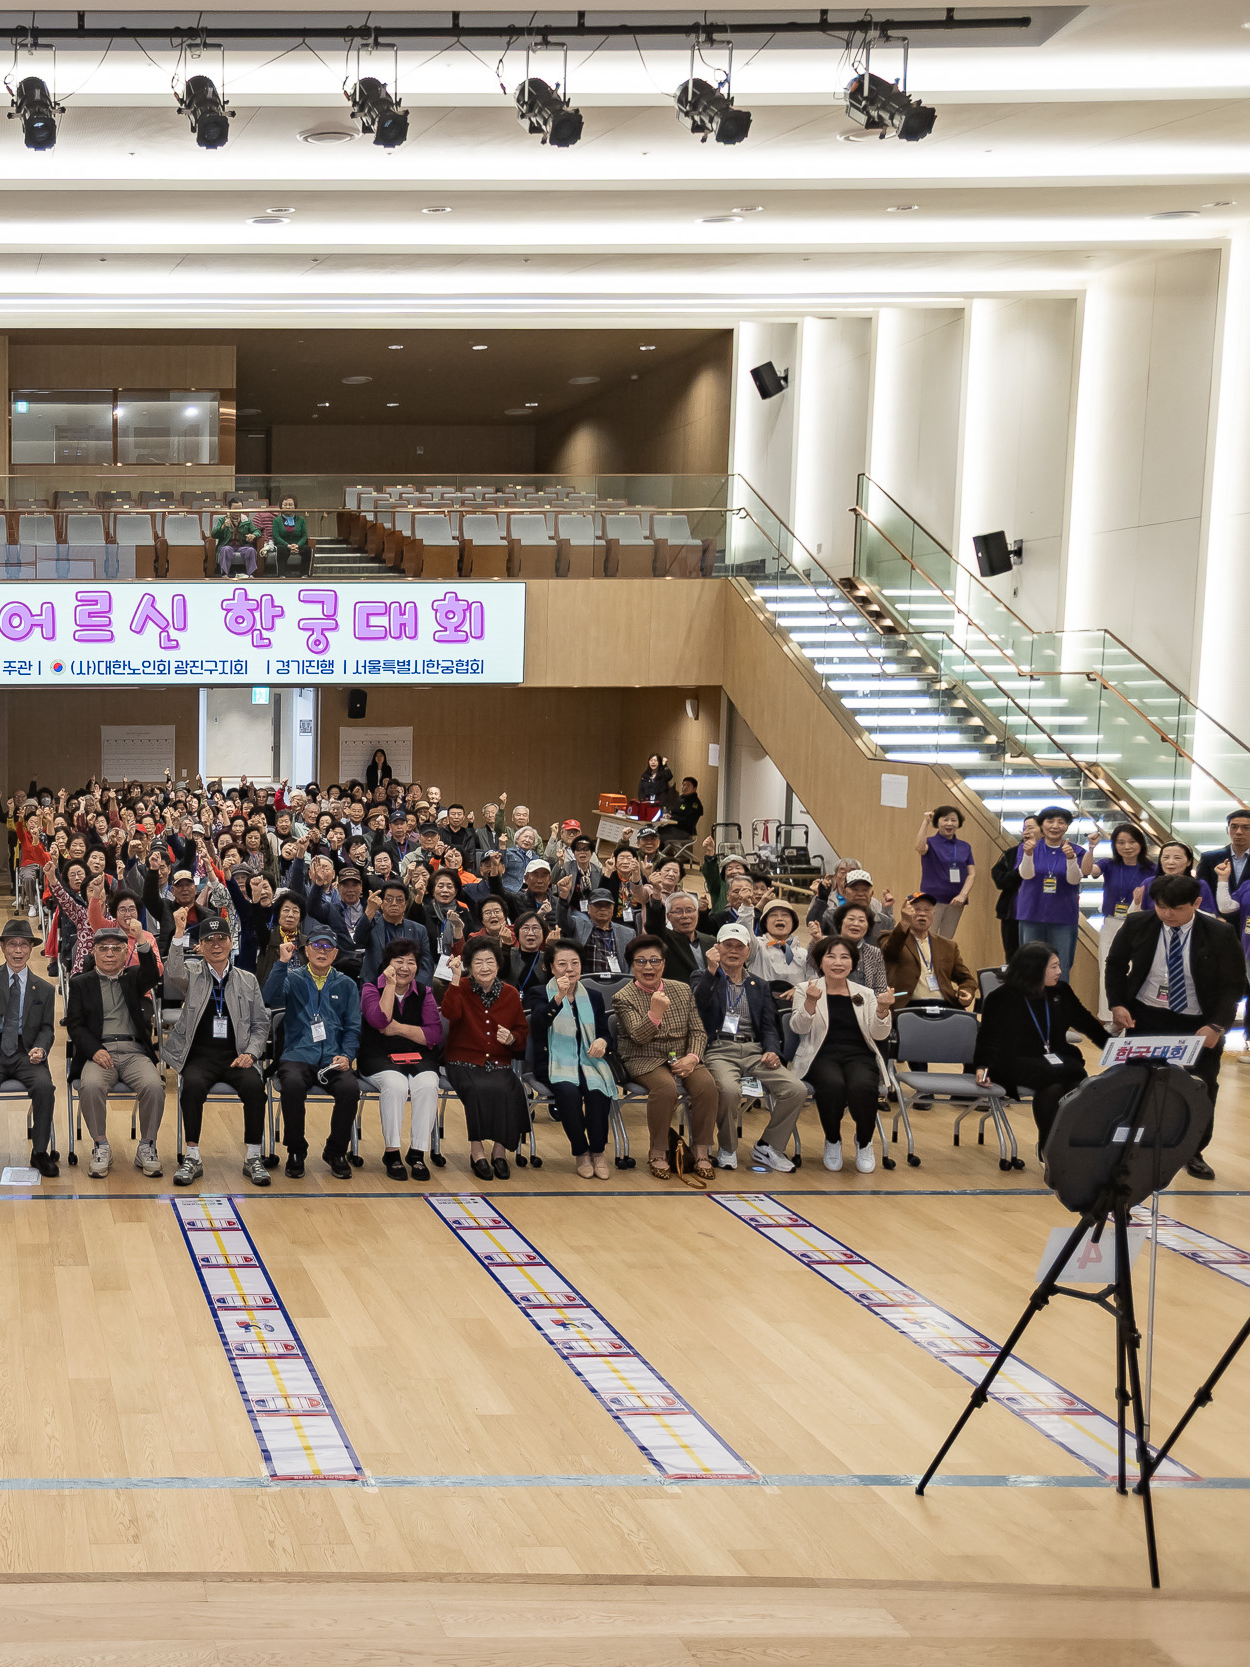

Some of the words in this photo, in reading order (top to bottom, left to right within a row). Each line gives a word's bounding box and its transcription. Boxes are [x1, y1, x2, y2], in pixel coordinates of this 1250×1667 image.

[220, 587, 486, 653] 한궁대회
[2, 660, 34, 676] 주관
[70, 659, 171, 675] (사)대한노인회
[174, 658, 248, 675] 광진구지회
[275, 659, 335, 675] 경기진행
[352, 658, 484, 675] 서울특별시한궁협회
